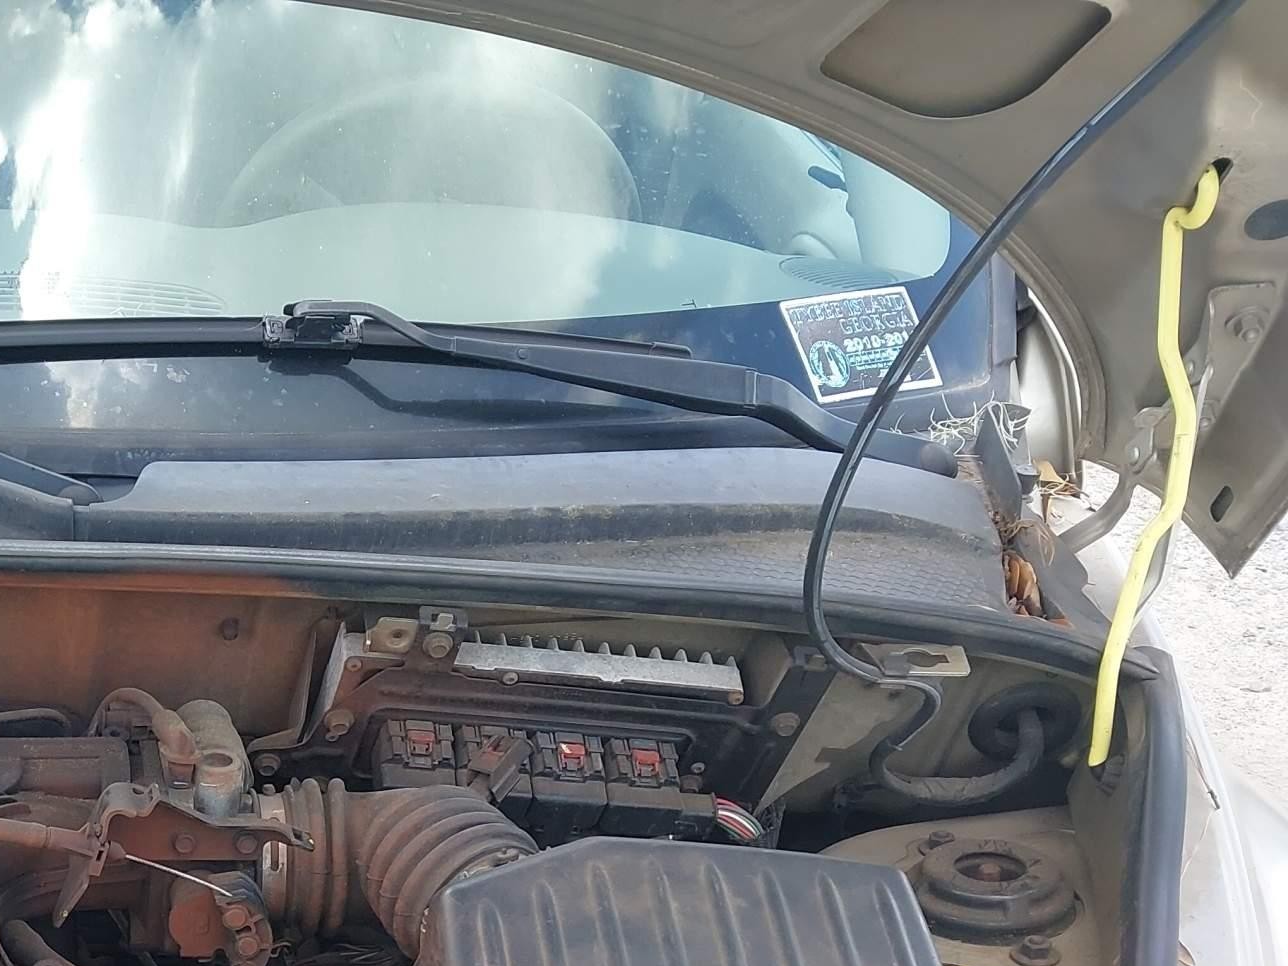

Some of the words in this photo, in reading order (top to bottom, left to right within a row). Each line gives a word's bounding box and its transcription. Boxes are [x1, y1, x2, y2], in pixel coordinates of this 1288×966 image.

[789, 302, 843, 324] TYBEE
[844, 294, 906, 317] ISLAND
[839, 311, 914, 334] GEORGIA
[844, 330, 910, 352] 2010-201
